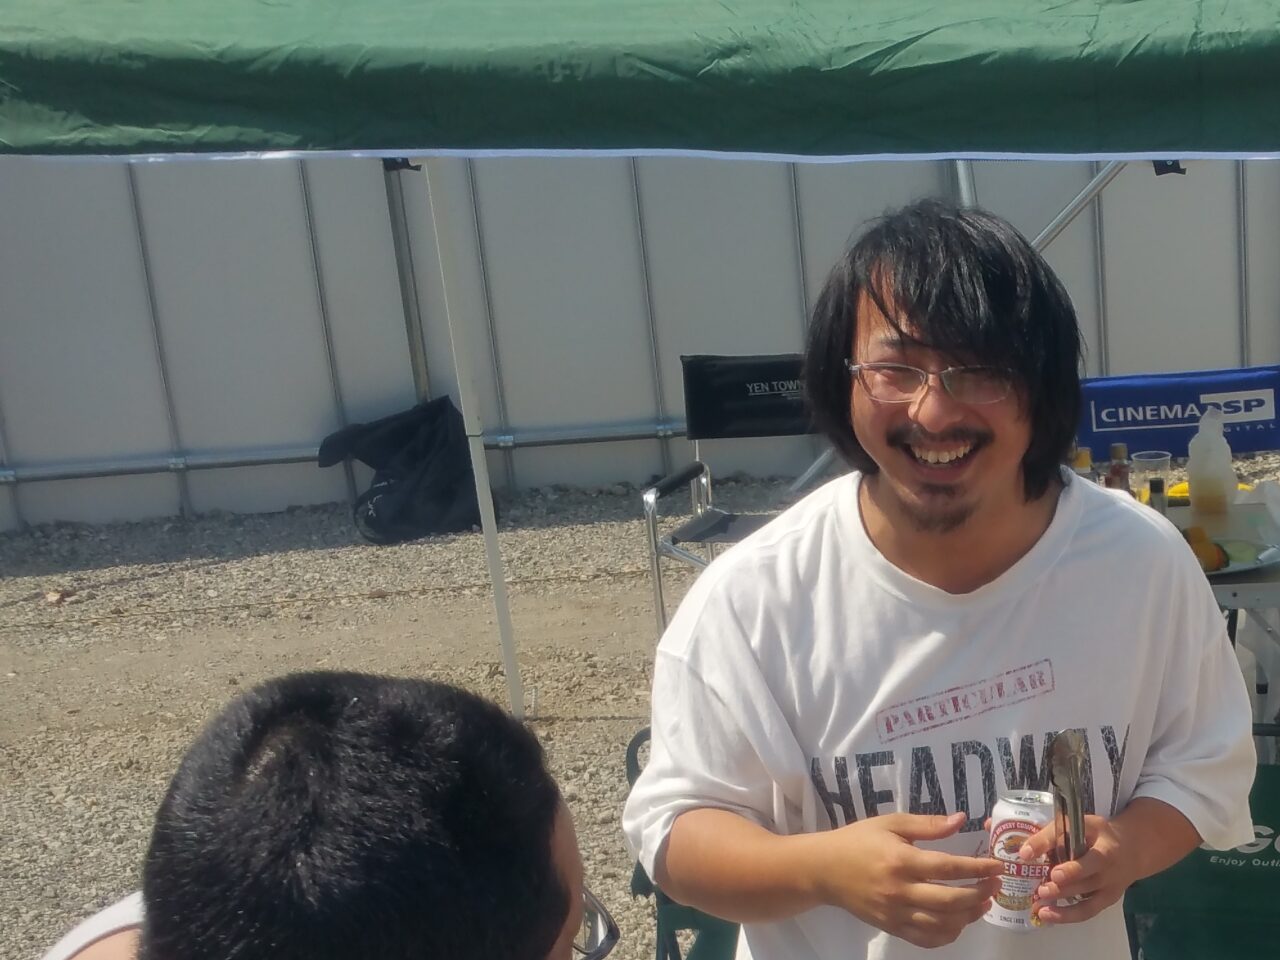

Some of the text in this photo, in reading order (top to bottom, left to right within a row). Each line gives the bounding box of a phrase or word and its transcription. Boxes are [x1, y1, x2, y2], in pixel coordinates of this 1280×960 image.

[746, 380, 800, 393] YEN TOW
[1101, 403, 1201, 423] CINEMA
[1223, 423, 1276, 433] GITAL
[1209, 855, 1246, 867] Enjoy
[1021, 864, 1050, 877] BEER
